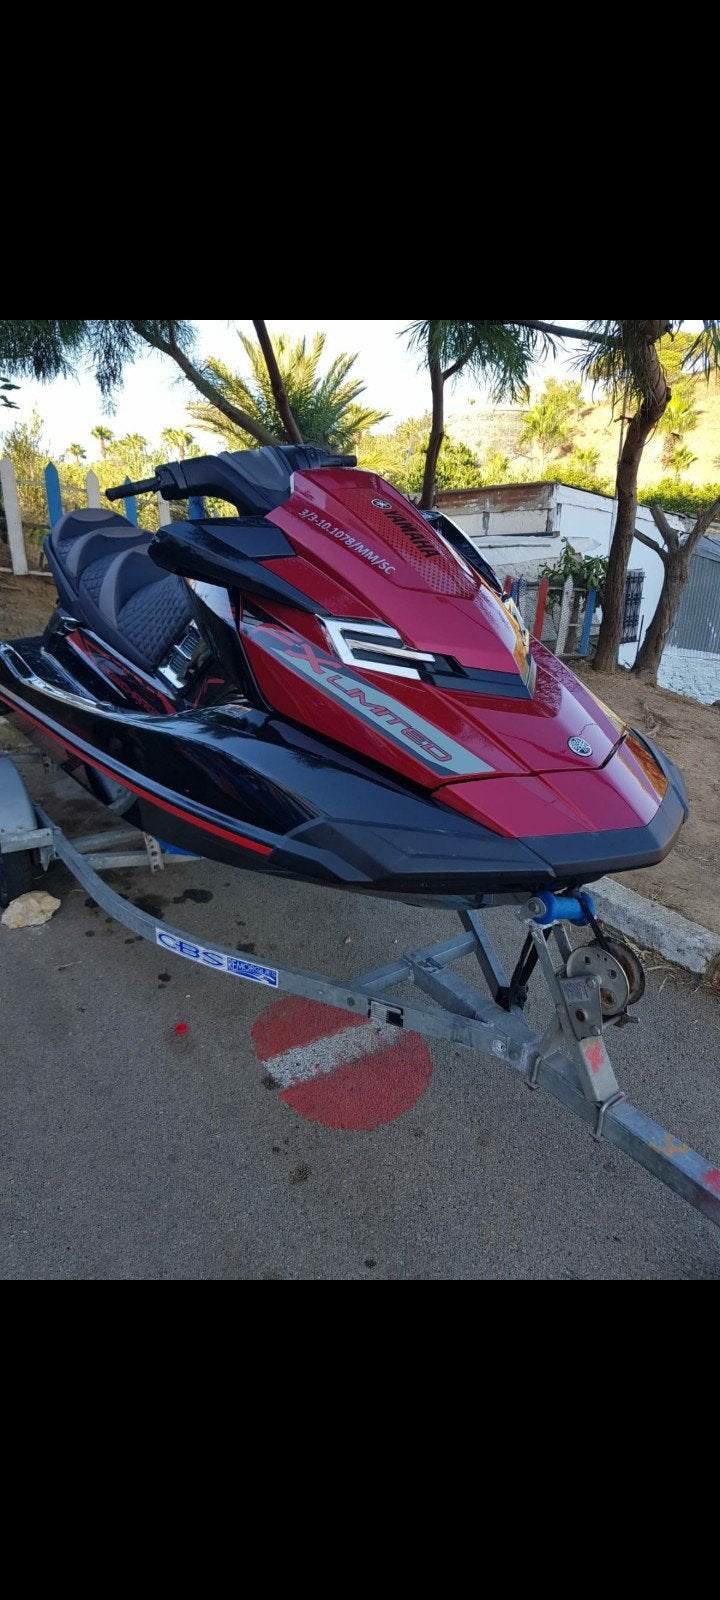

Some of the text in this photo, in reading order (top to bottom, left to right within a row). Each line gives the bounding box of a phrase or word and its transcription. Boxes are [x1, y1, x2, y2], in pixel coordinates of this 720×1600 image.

[384, 510, 440, 558] YAMAHA
[251, 623, 453, 763] FX LIMITED
[158, 933, 224, 966] CBS
